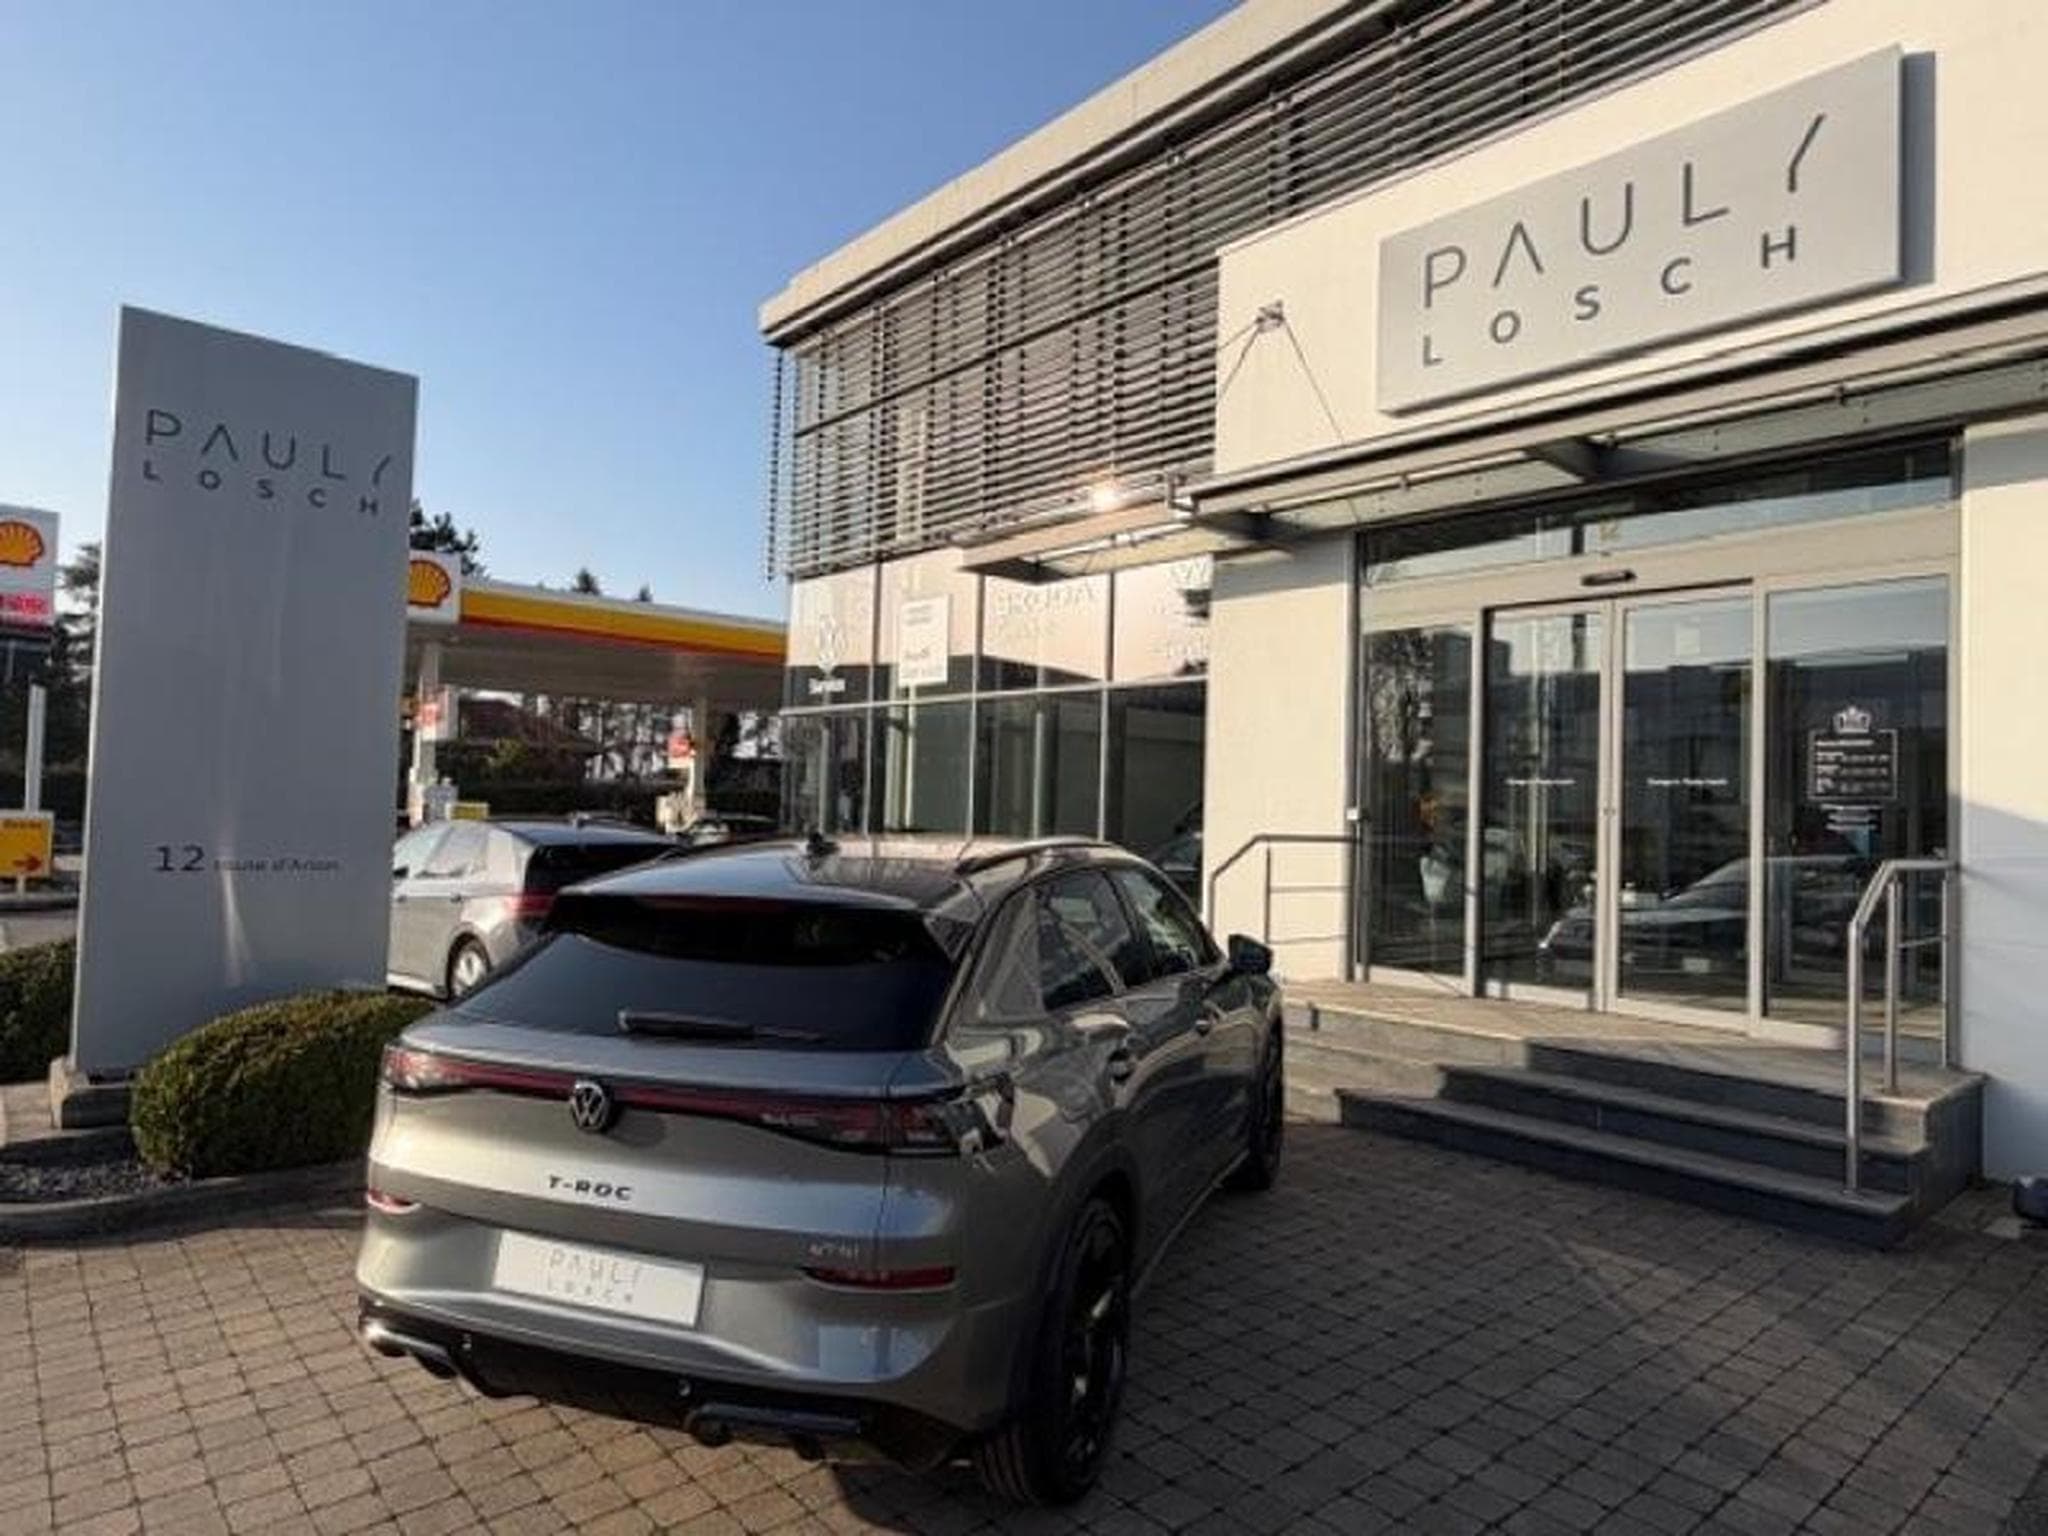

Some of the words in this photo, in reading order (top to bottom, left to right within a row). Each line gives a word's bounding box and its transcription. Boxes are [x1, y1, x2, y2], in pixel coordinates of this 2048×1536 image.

[1424, 112, 1827, 310] PAULY
[1422, 225, 1796, 368] LOSCH
[145, 408, 392, 486] PAULY
[142, 459, 379, 516] LOSCH
[155, 845, 204, 872] 12
[549, 1174, 633, 1201] T-ROC
